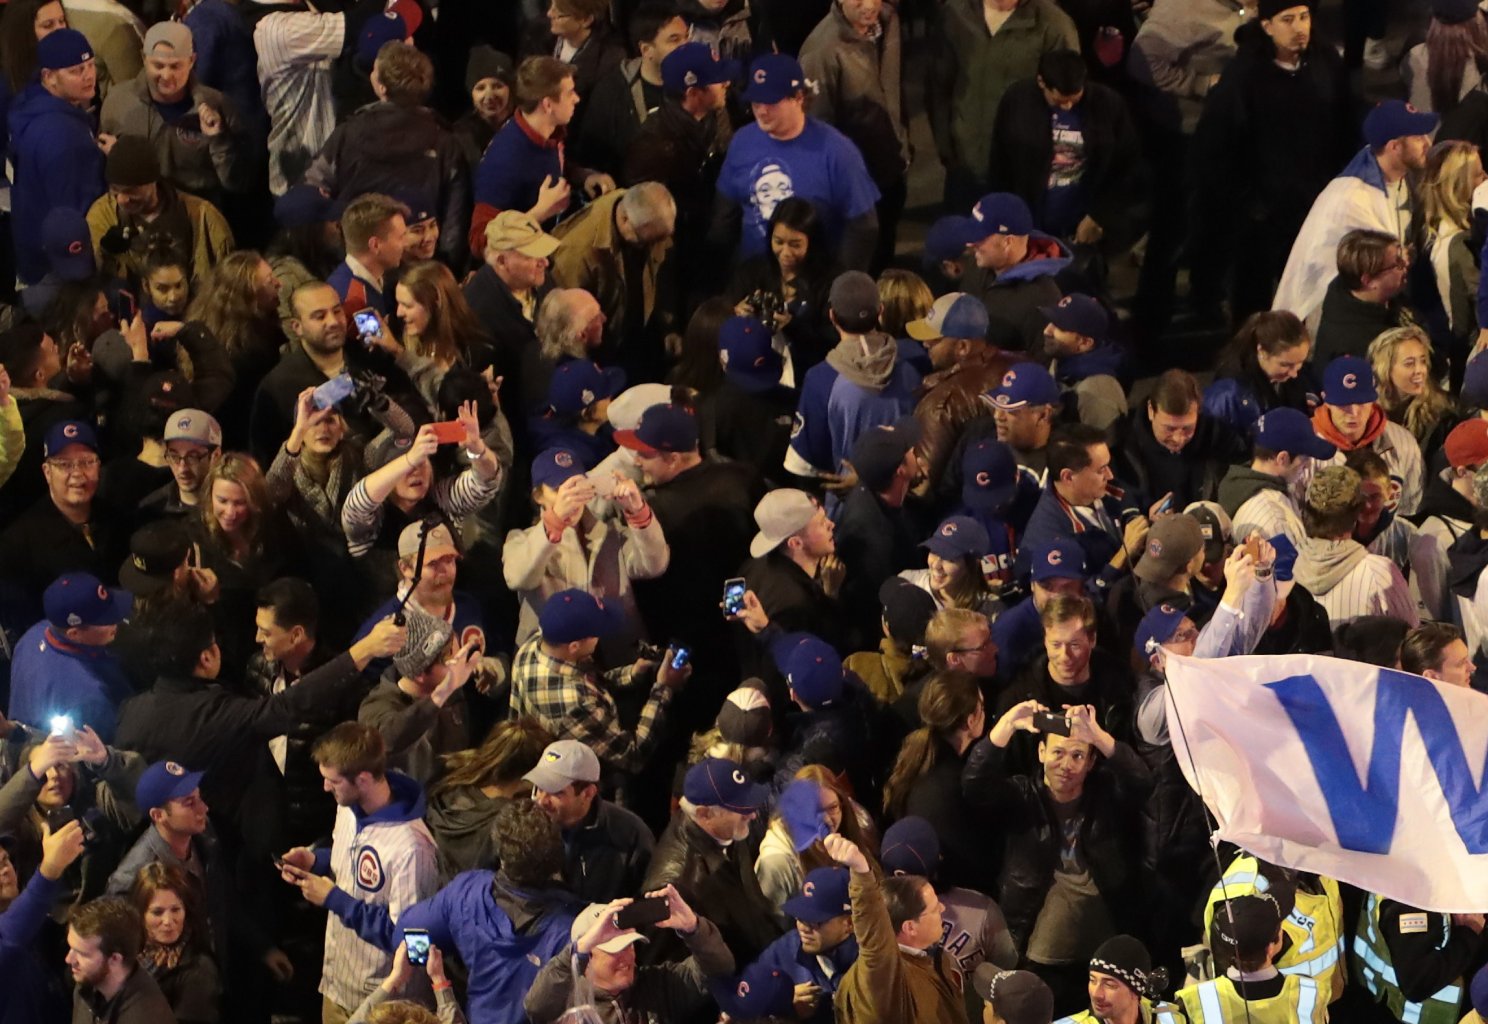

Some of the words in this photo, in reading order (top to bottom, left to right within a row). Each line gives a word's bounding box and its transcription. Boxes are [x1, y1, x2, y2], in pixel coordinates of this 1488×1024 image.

[753, 70, 767, 85] C
[1004, 370, 1019, 387] C
[1343, 373, 1358, 389] C
[64, 423, 81, 438] C
[976, 470, 992, 486] C
[940, 522, 958, 537] C
[1047, 550, 1063, 566] C
[733, 769, 746, 785] C
[803, 881, 816, 898] C
